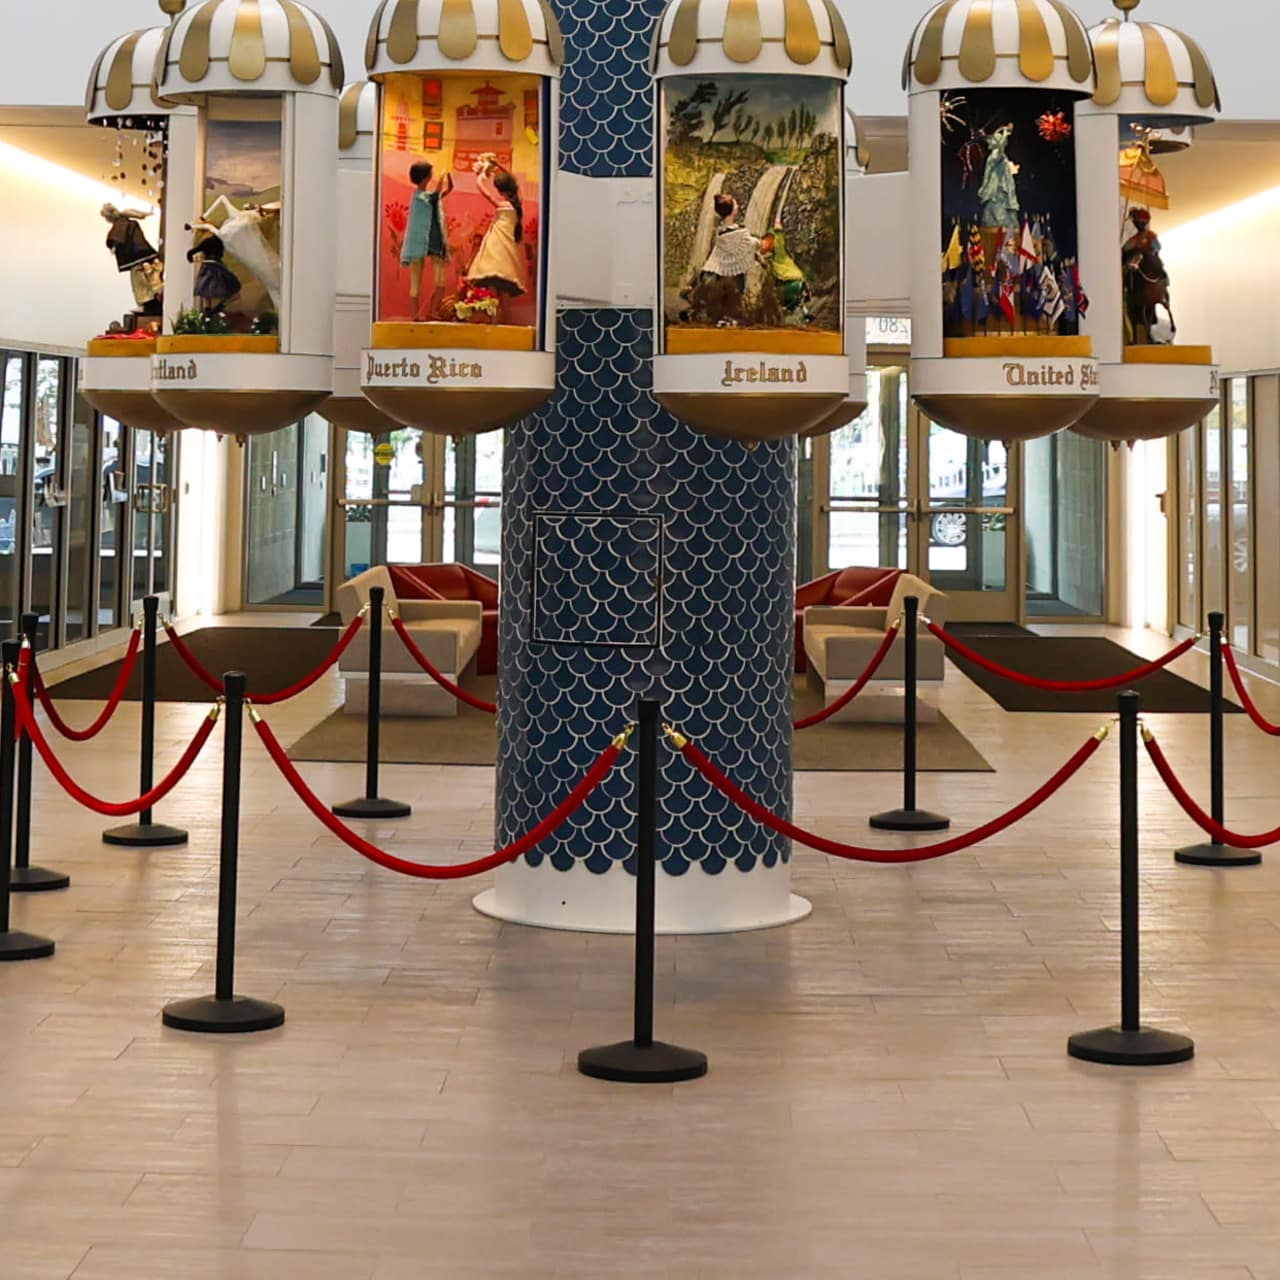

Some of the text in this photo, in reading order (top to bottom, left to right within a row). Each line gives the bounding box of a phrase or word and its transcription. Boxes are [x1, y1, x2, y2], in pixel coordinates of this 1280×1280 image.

[366, 351, 482, 384] Puerto Rico
[721, 360, 808, 387] Ireland
[1002, 363, 1074, 386] United
